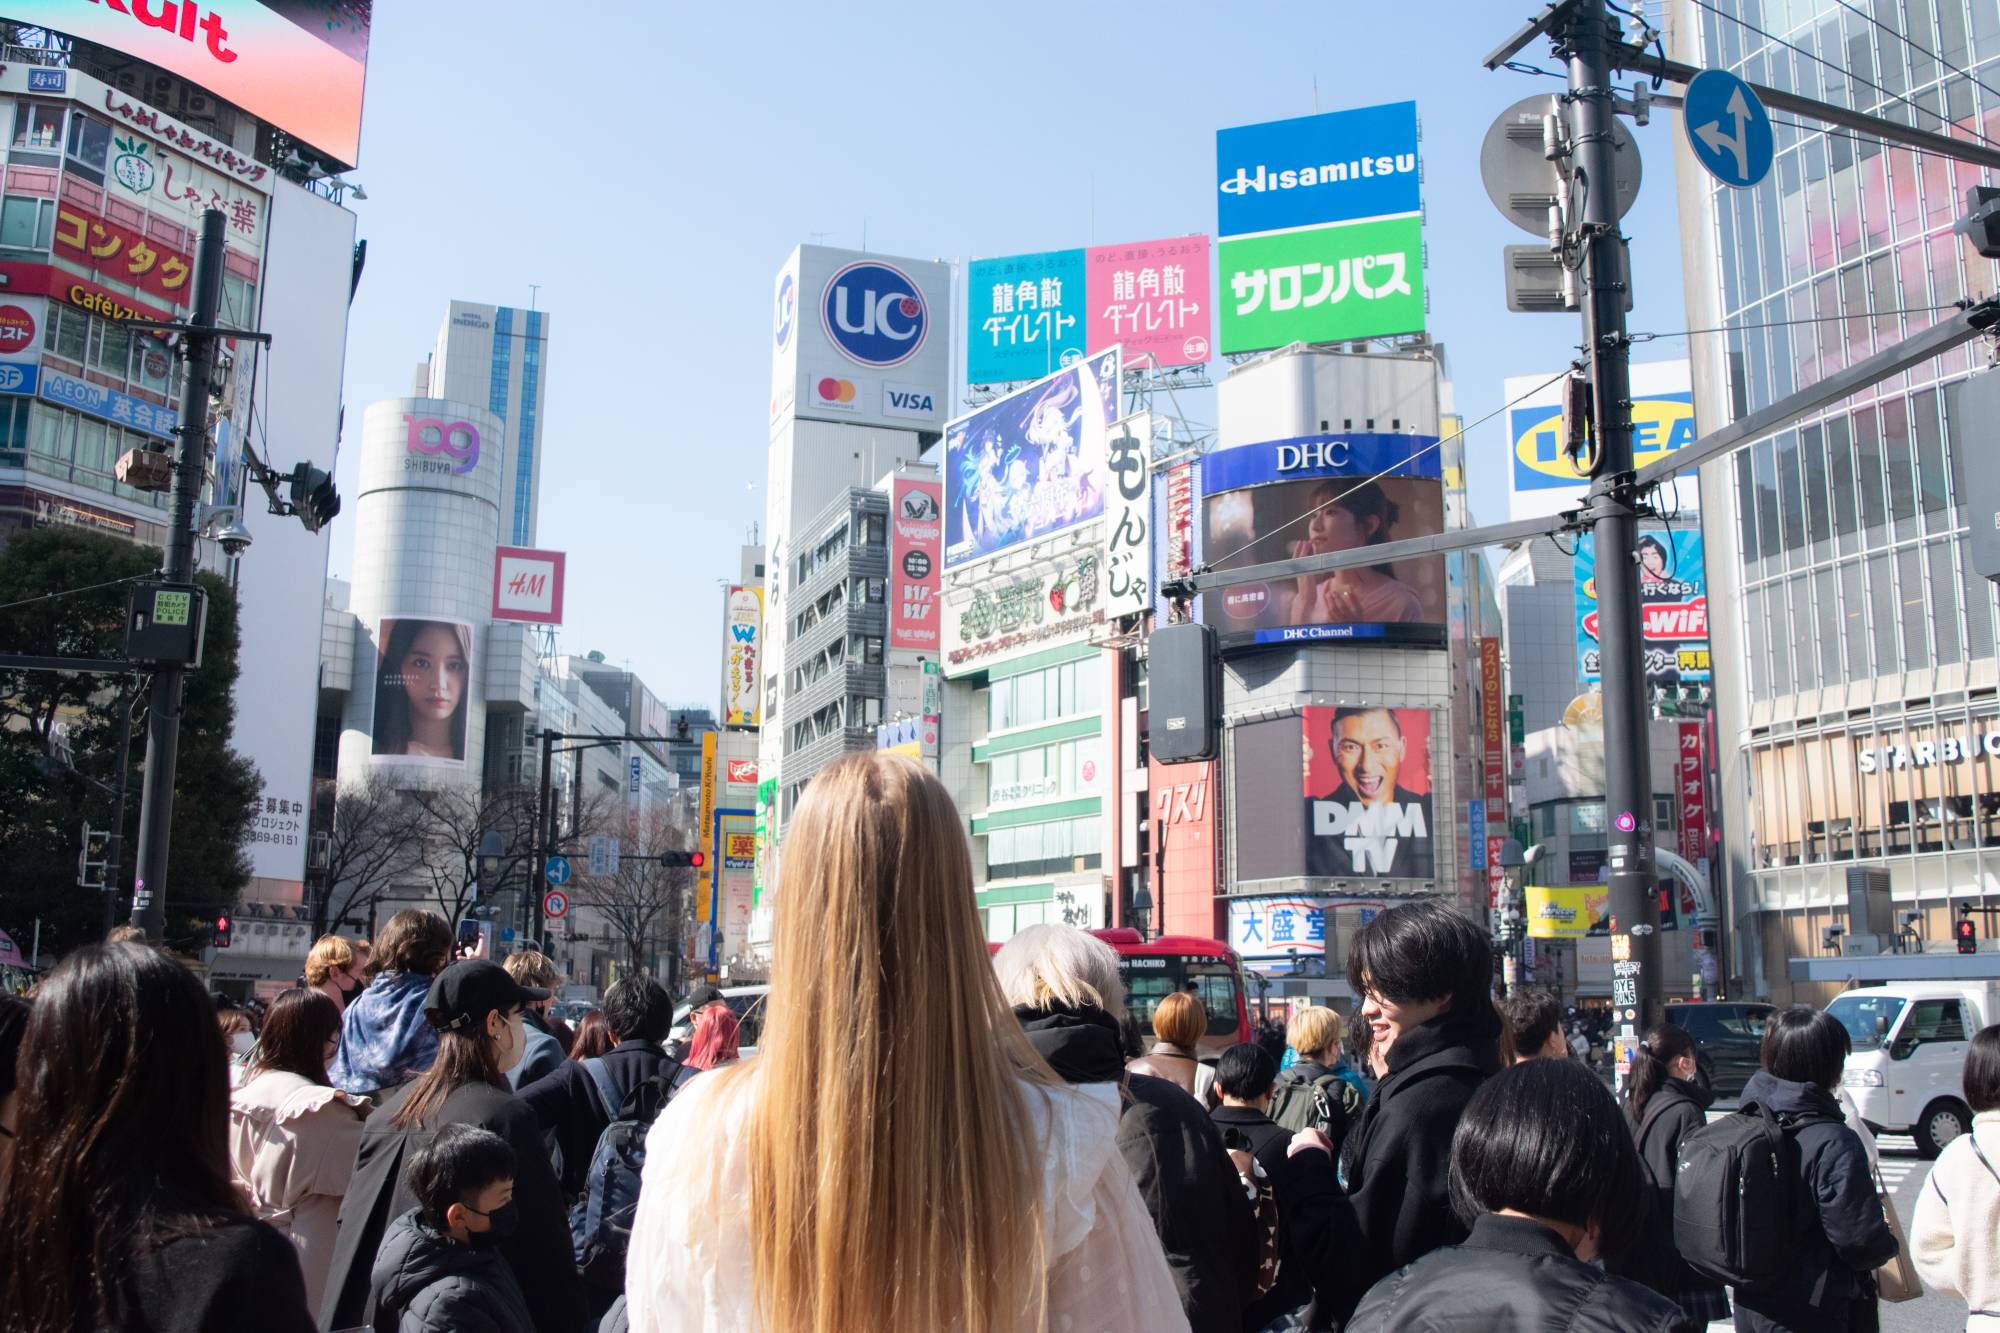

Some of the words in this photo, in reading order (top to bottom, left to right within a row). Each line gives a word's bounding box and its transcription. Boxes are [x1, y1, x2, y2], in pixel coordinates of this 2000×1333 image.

[32, 73, 61, 87] 寿司
[105, 89, 267, 182] しゃぶしゃぶバイキング
[1220, 153, 1415, 195] Hisamitsu
[164, 163, 257, 235] しゃぶ葉
[992, 277, 1062, 314] 龍角散
[1113, 264, 1185, 301] 龍角散
[1231, 252, 1411, 316] サロンパス
[453, 318, 490, 329] INDIGO
[836, 286, 917, 340] UC
[982, 312, 1076, 347] ダイレクト
[1103, 299, 1199, 335] ダイレクト
[53, 377, 100, 407] AEON
[888, 391, 933, 412] VISA
[112, 397, 175, 434] 英会話
[404, 415, 481, 474] 109
[1277, 441, 1349, 472] DHC
[1536, 417, 1695, 463] IEA
[404, 459, 451, 475] SHIBUYA
[1108, 422, 1147, 605] もんじゃ
[508, 572, 546, 598] H&M
[1284, 628, 1308, 639] DHC
[1310, 626, 1353, 638] Channel
[1483, 643, 1498, 742] クスリのことなら
[1682, 734, 1701, 817] カラオケ
[703, 792, 713, 838] Matsumoto
[1313, 800, 1428, 838] DMM
[1344, 837, 1398, 873] TV
[1131, 959, 1166, 968] HACHIKO
